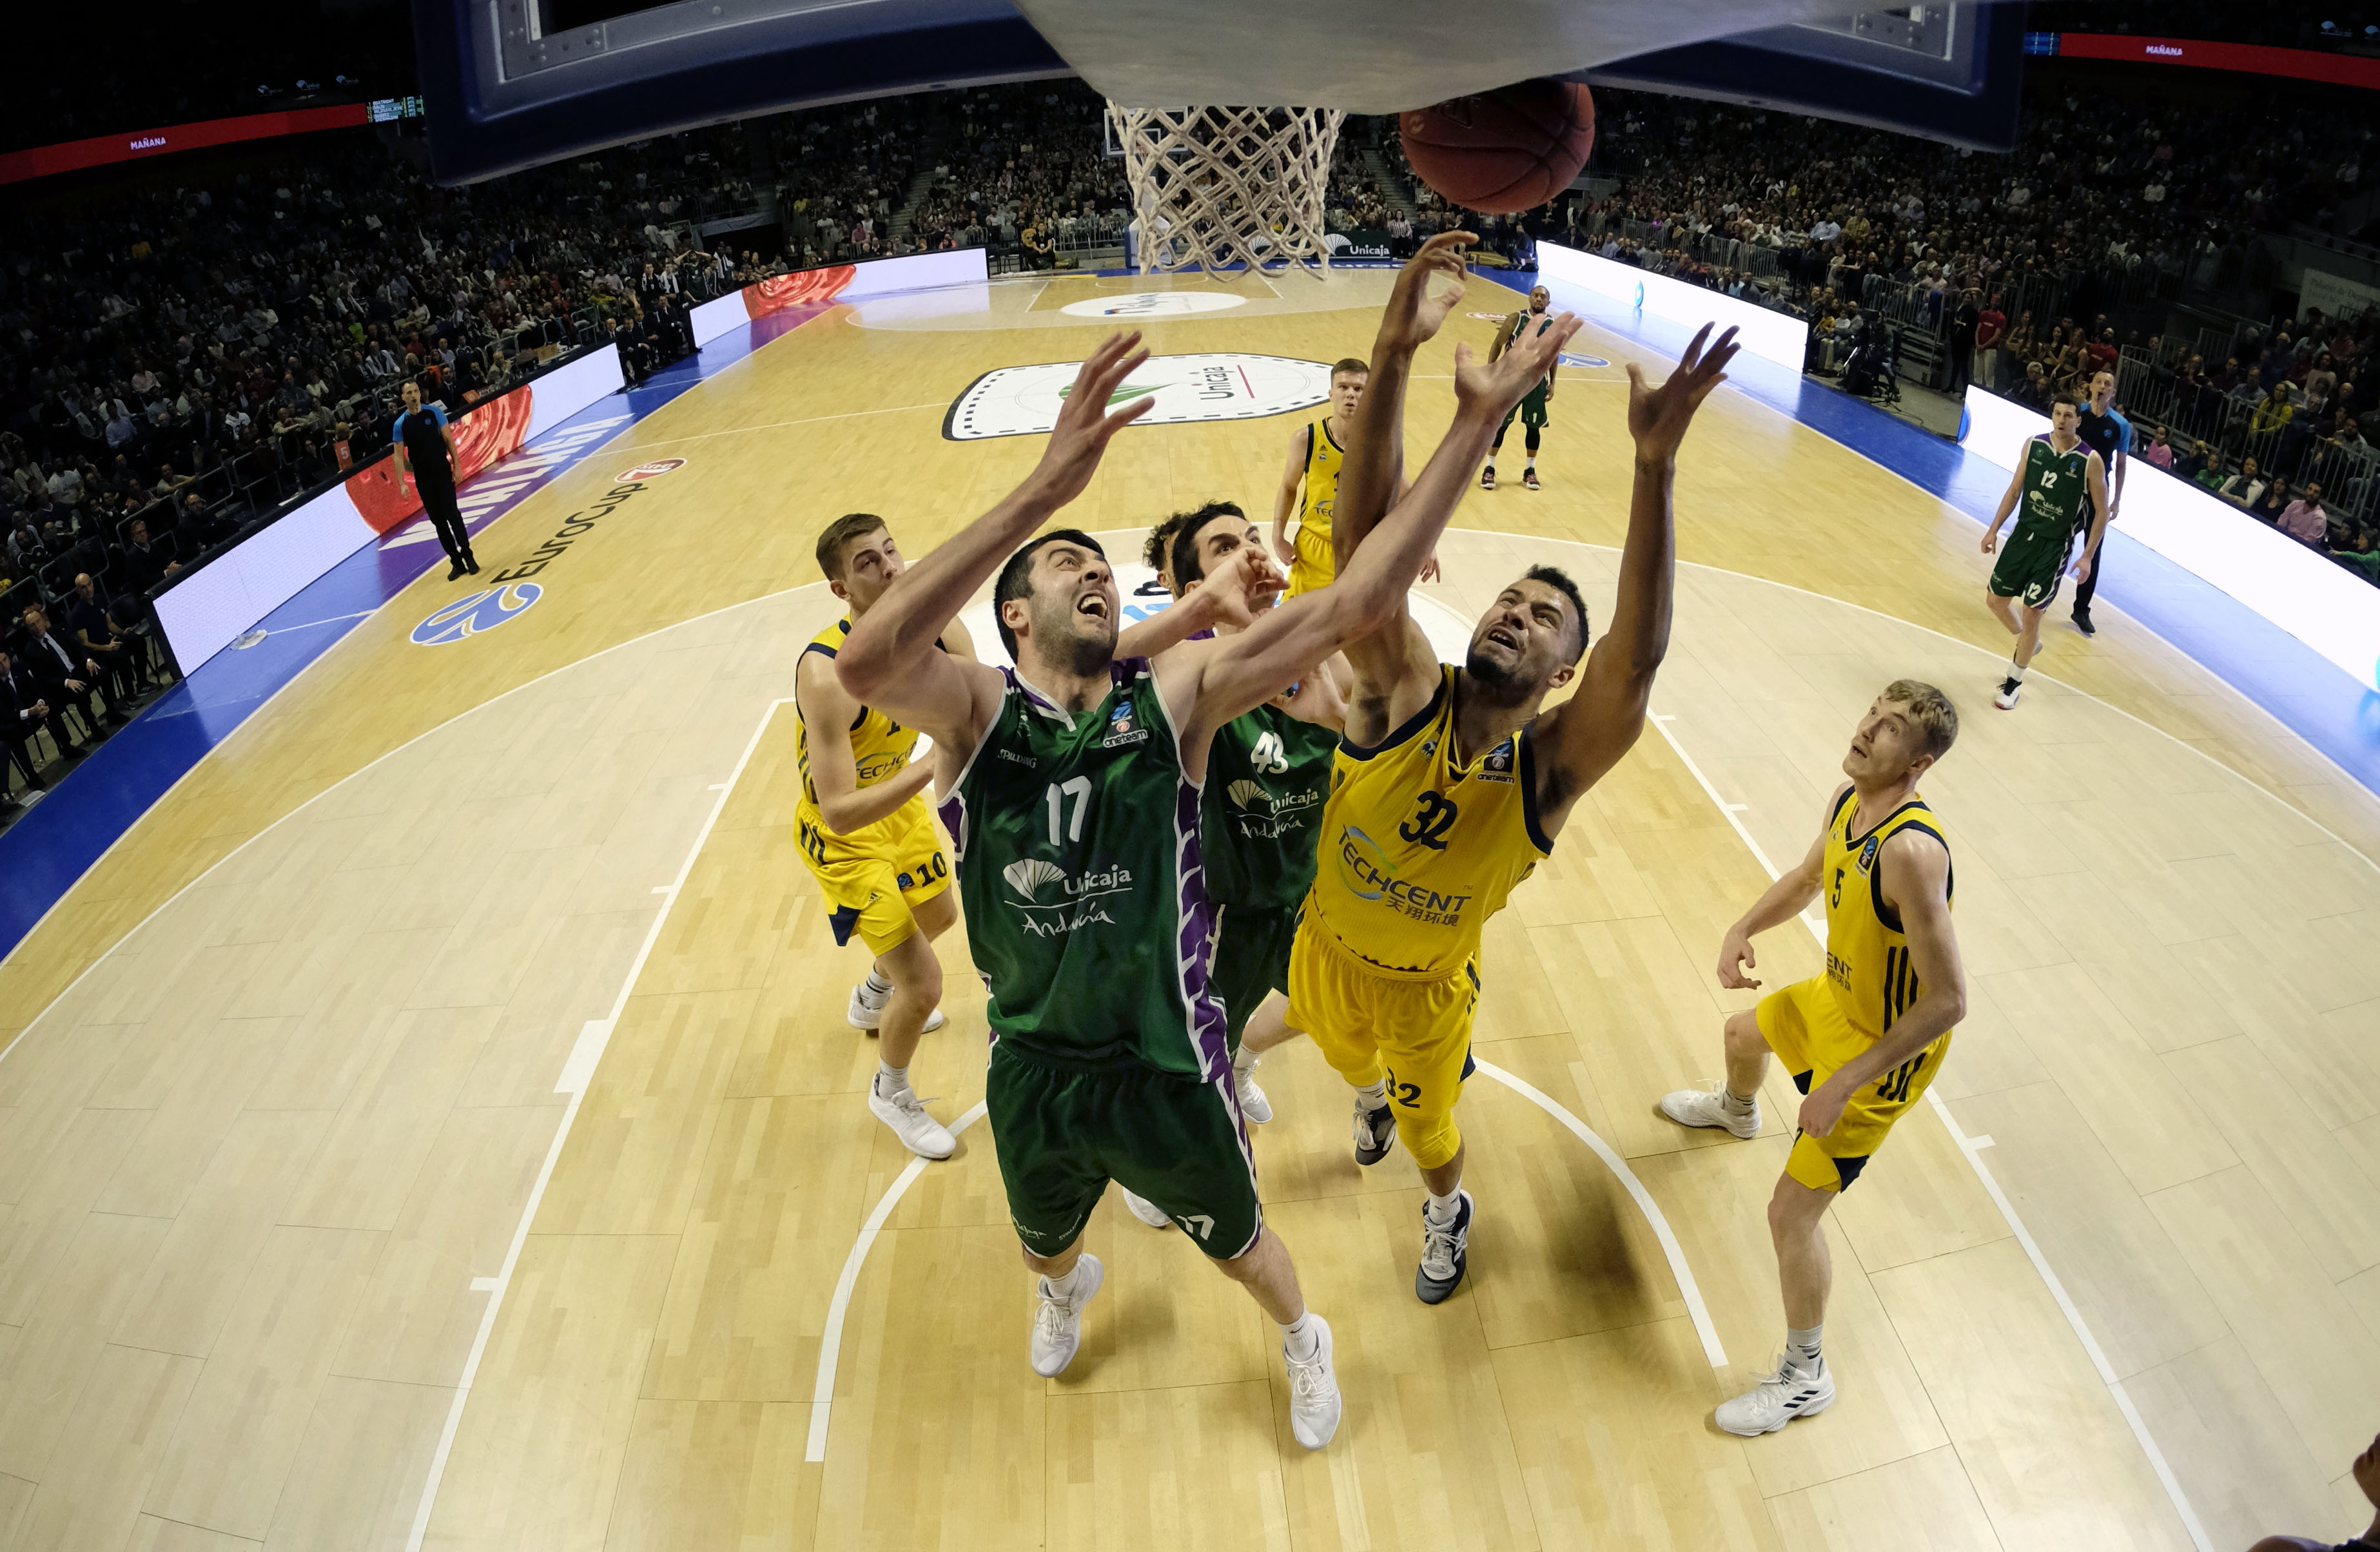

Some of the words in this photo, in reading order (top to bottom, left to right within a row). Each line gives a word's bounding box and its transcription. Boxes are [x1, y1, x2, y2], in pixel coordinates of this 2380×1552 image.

[2146, 44, 2183, 56] MAÑANA
[130, 137, 166, 150] MAÑANA
[1350, 244, 1390, 257] Unicaja
[1189, 367, 1235, 400] Unicaja
[340, 447, 349, 459] 5
[2041, 470, 2058, 489] 12
[2027, 582, 2042, 600] 12
[1105, 731, 1147, 746] oneteam
[1478, 773, 1515, 784] oneteam
[1046, 775, 1092, 846] 17
[1399, 790, 1458, 850] 32
[917, 851, 947, 888] 10
[1064, 864, 1133, 895] Uicaja
[1338, 824, 1472, 912] TECHCENT
[1832, 868, 1845, 909] 5
[1386, 896, 1460, 927] 天翔环境
[1386, 1066, 1421, 1109] 32
